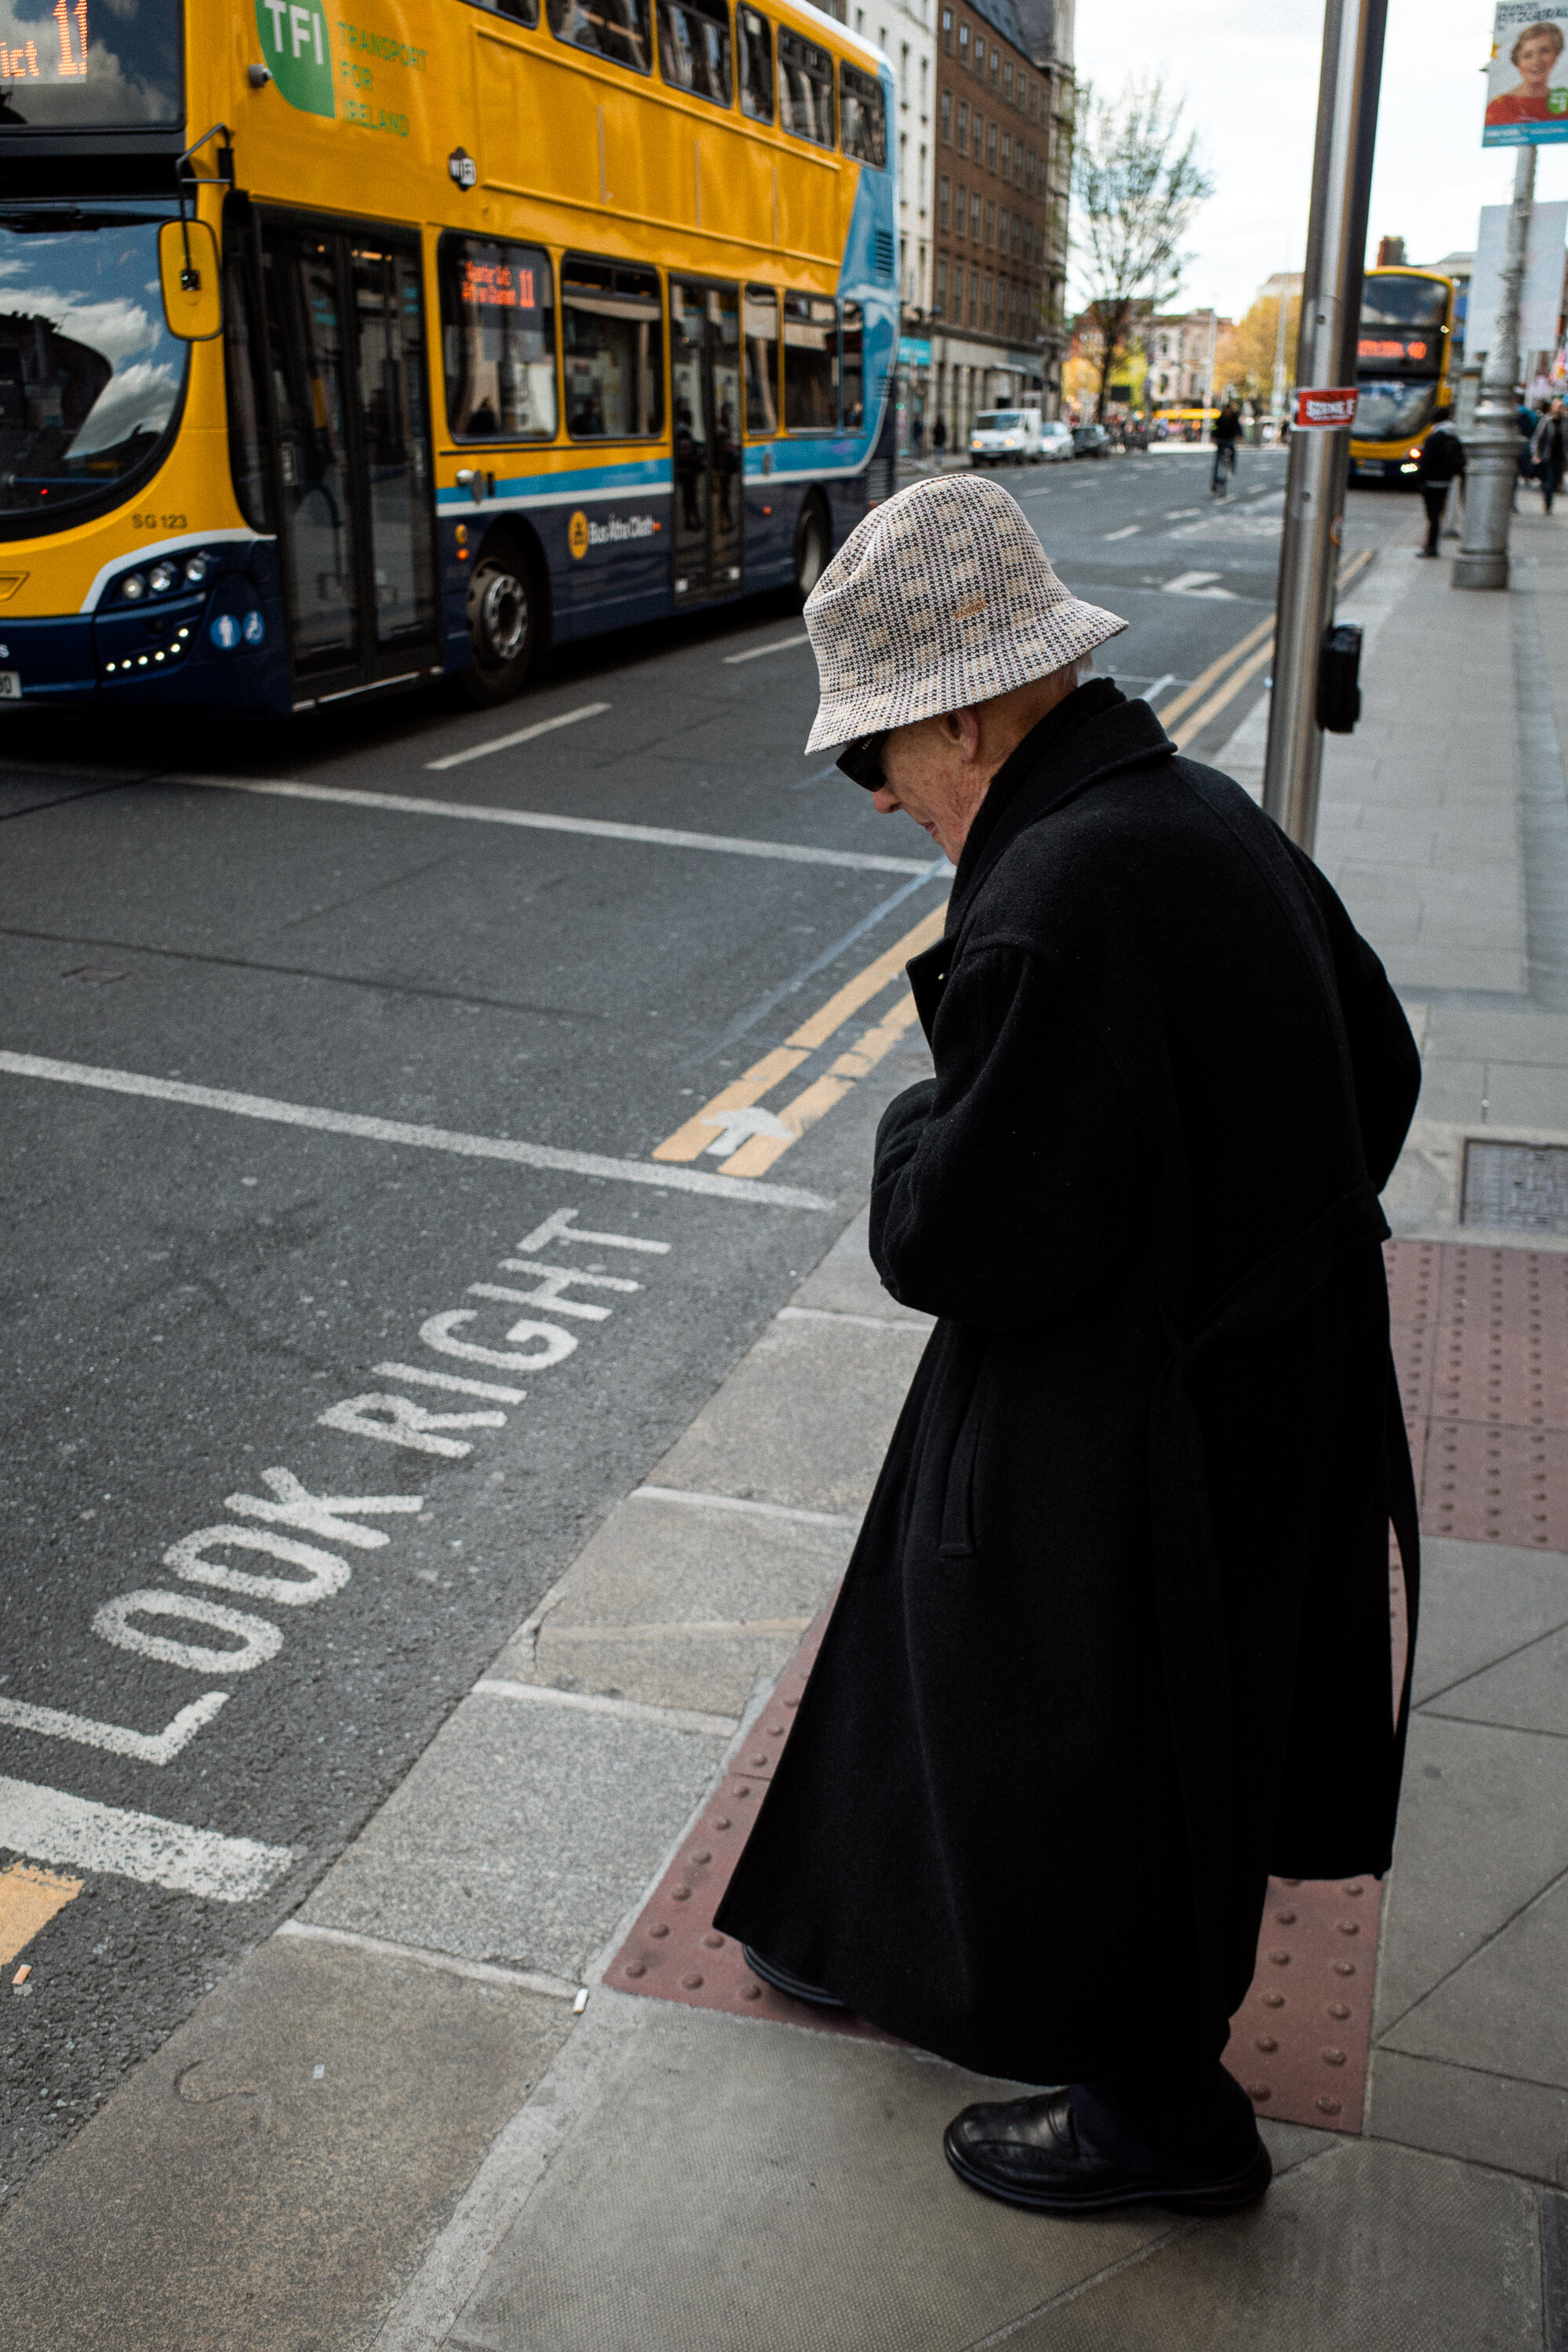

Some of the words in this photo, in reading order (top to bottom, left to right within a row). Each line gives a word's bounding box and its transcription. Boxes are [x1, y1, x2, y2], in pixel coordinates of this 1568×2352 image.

[264, 0, 324, 65] TFI
[338, 21, 427, 73] TRANSPORT
[340, 60, 373, 93] FOR
[343, 99, 410, 136] IRELAND
[519, 268, 535, 308] 11
[132, 514, 157, 529] SG
[161, 514, 187, 529] 123
[0, 1466, 423, 1766] LOOK
[318, 1208, 672, 1458] RIGHT
